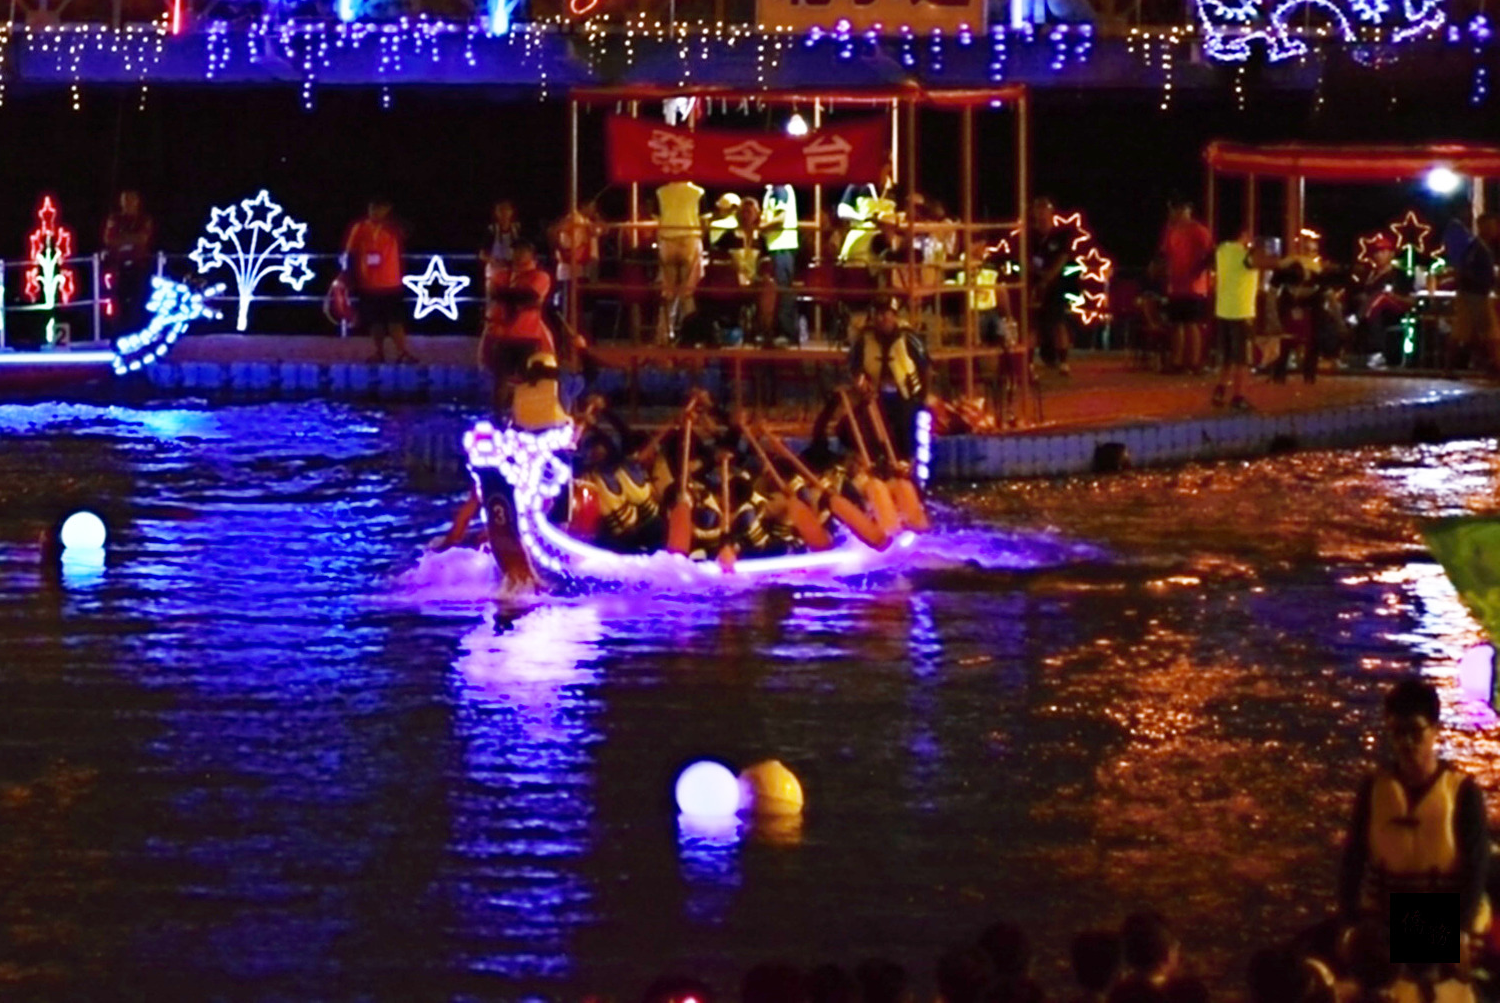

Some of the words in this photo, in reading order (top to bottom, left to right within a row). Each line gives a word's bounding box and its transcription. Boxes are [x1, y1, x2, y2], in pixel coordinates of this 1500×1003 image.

[648, 129, 852, 182] 發令台
[493, 504, 507, 526] 3
